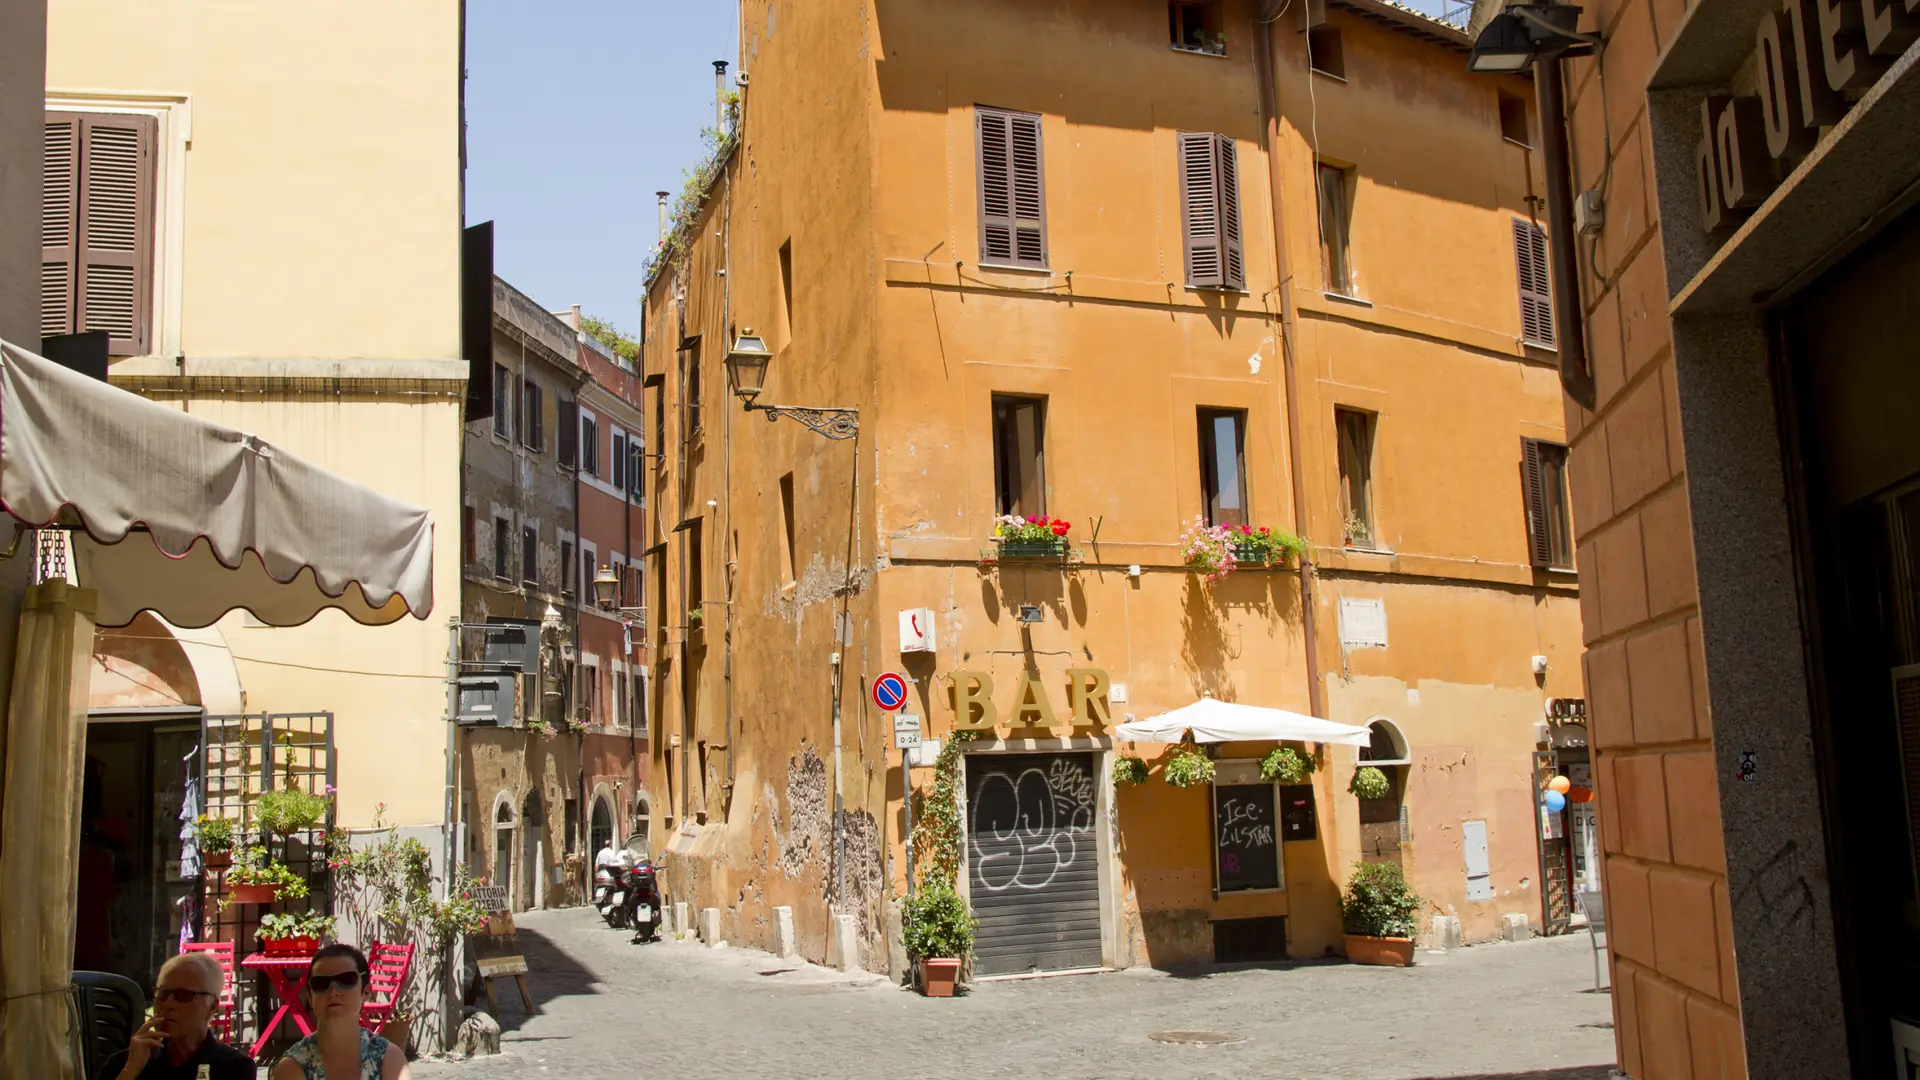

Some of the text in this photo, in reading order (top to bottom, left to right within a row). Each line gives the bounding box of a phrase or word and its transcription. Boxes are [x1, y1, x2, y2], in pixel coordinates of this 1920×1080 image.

[1696, 0, 1920, 233] da OTE
[947, 668, 1112, 731] BAR
[466, 887, 507, 899] RATTORIA
